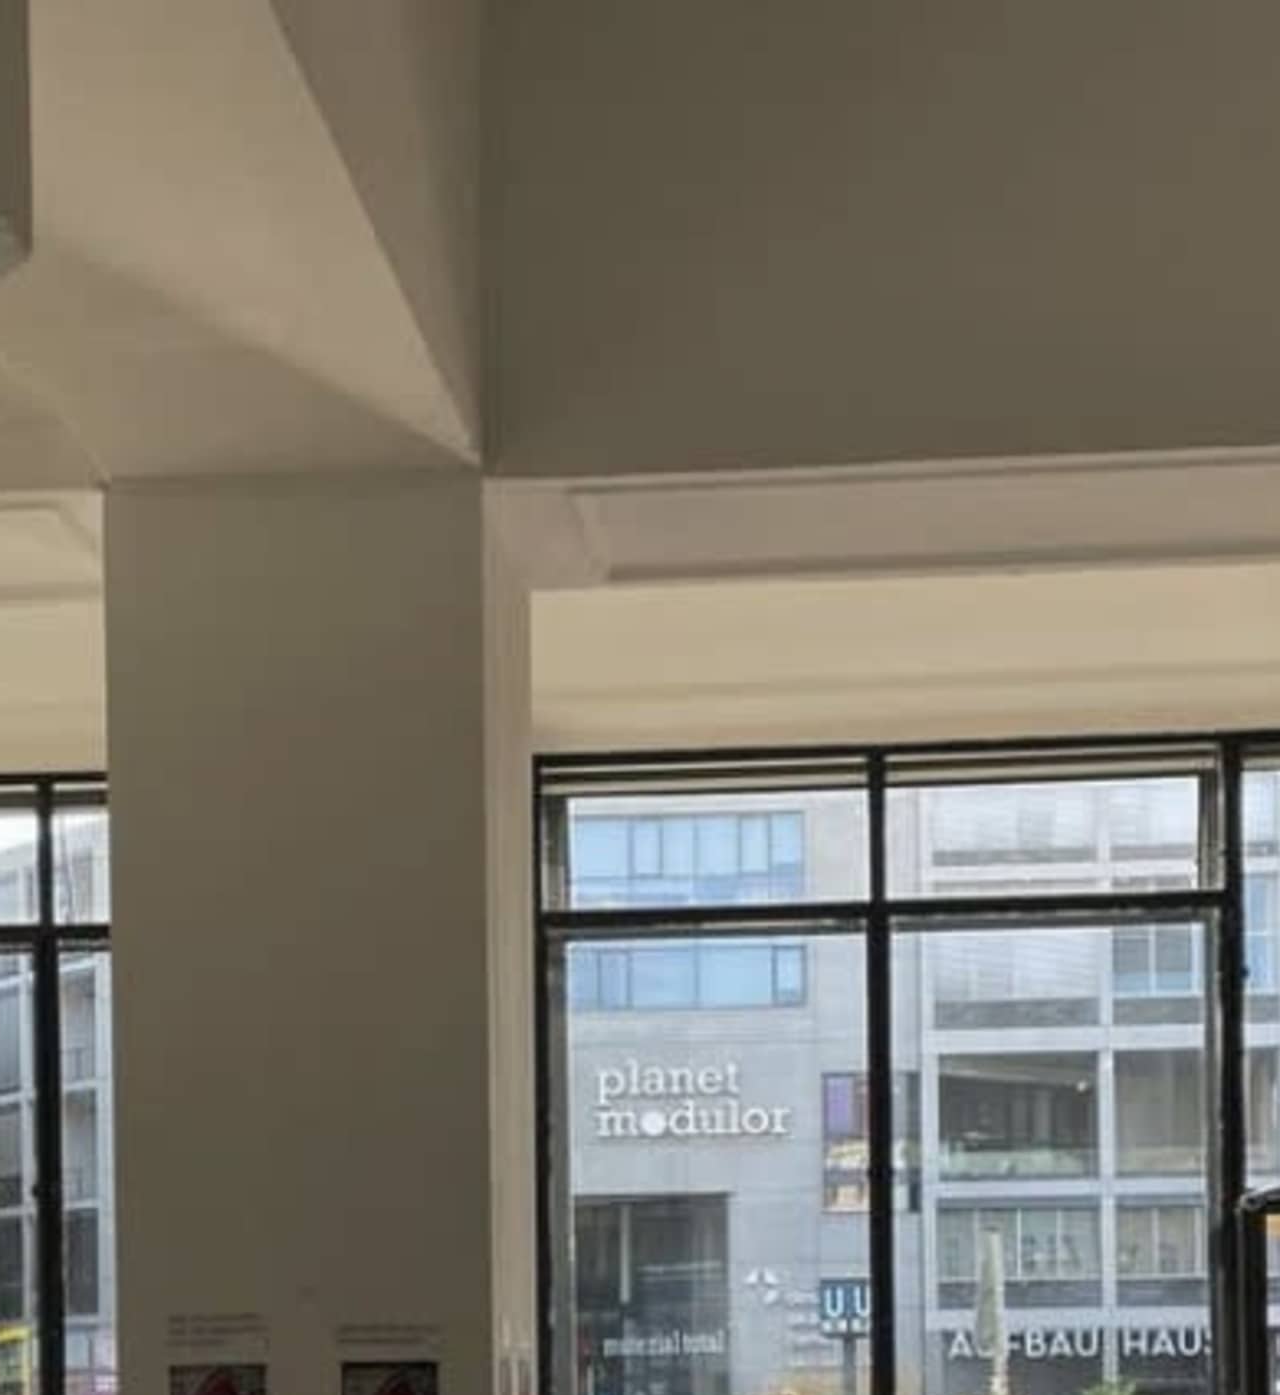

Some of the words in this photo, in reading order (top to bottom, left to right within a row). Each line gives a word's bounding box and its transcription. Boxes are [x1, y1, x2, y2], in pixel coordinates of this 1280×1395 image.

[597, 1059, 740, 1104] planet
[595, 1103, 791, 1137] modulor
[825, 1286, 845, 1318] U
